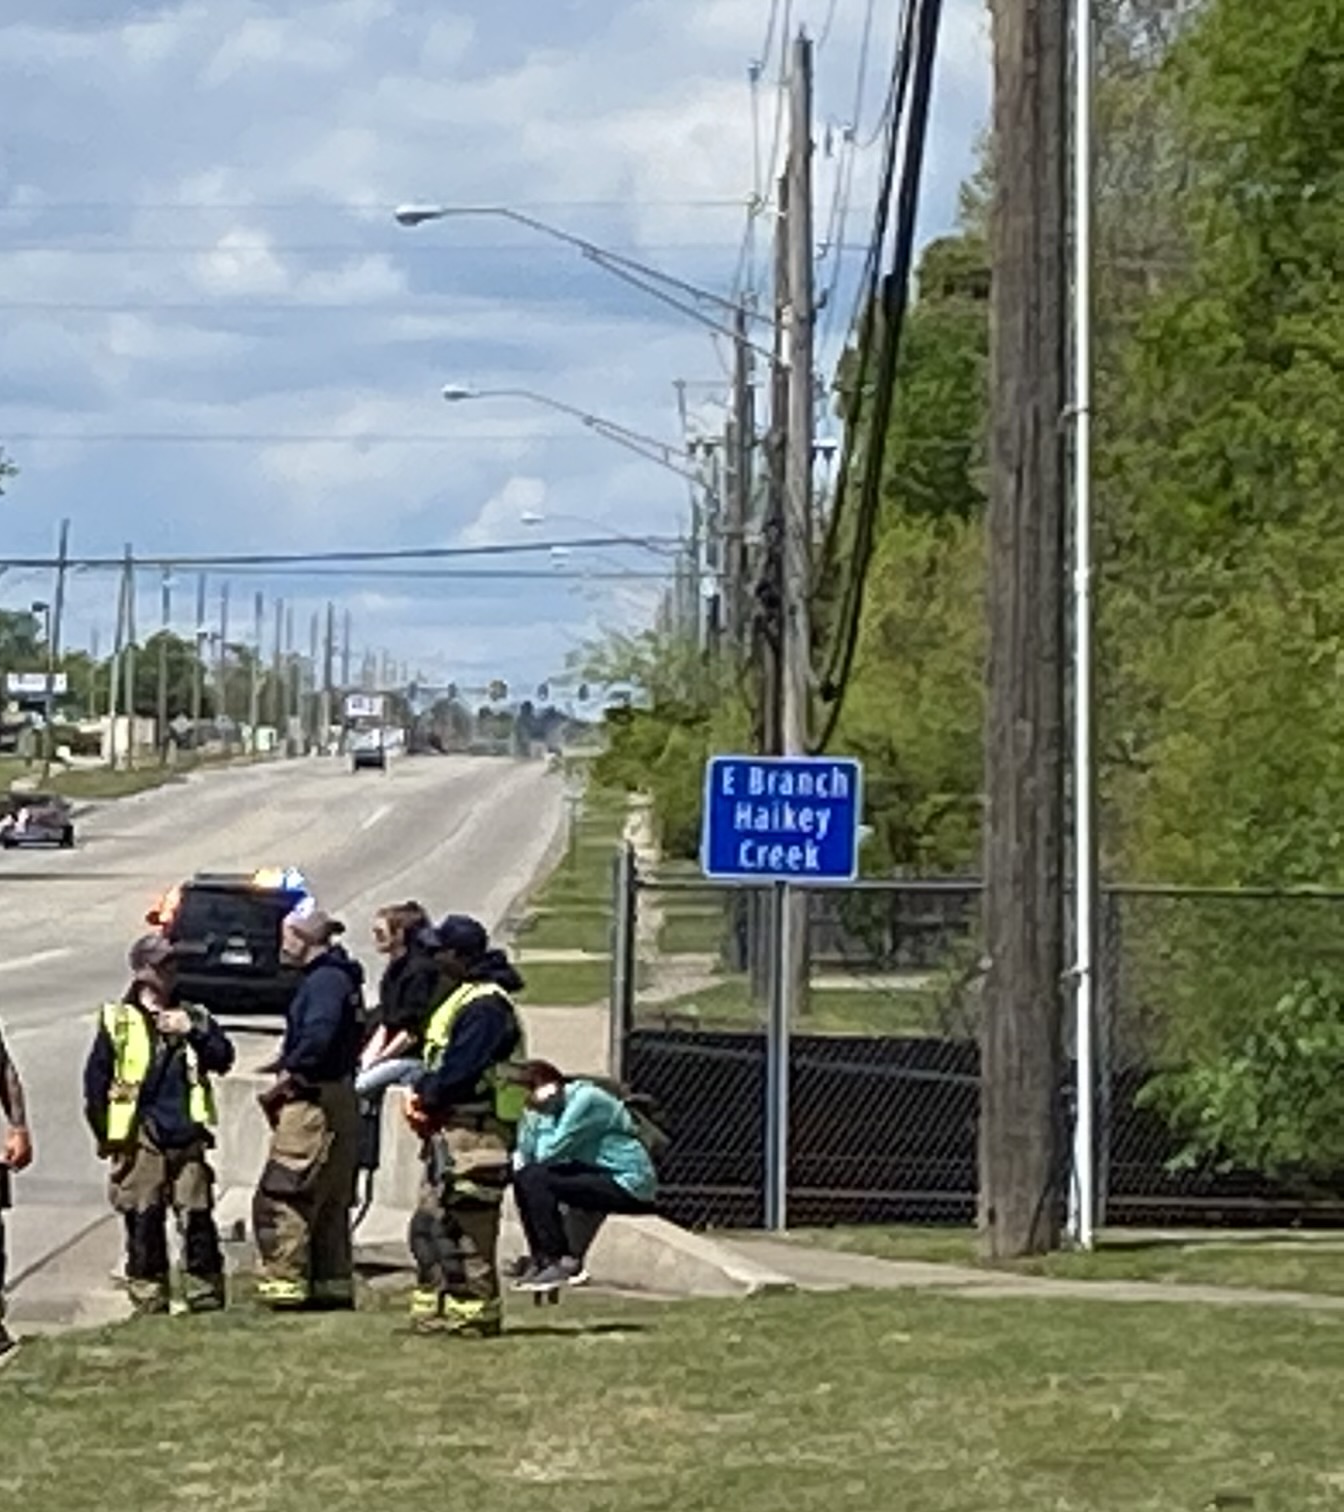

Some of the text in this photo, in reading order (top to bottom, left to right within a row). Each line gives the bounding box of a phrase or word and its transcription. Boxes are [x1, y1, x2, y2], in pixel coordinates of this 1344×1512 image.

[722, 766, 849, 798] E Branch
[733, 801, 831, 840] Haikey
[738, 838, 820, 870] Creek
